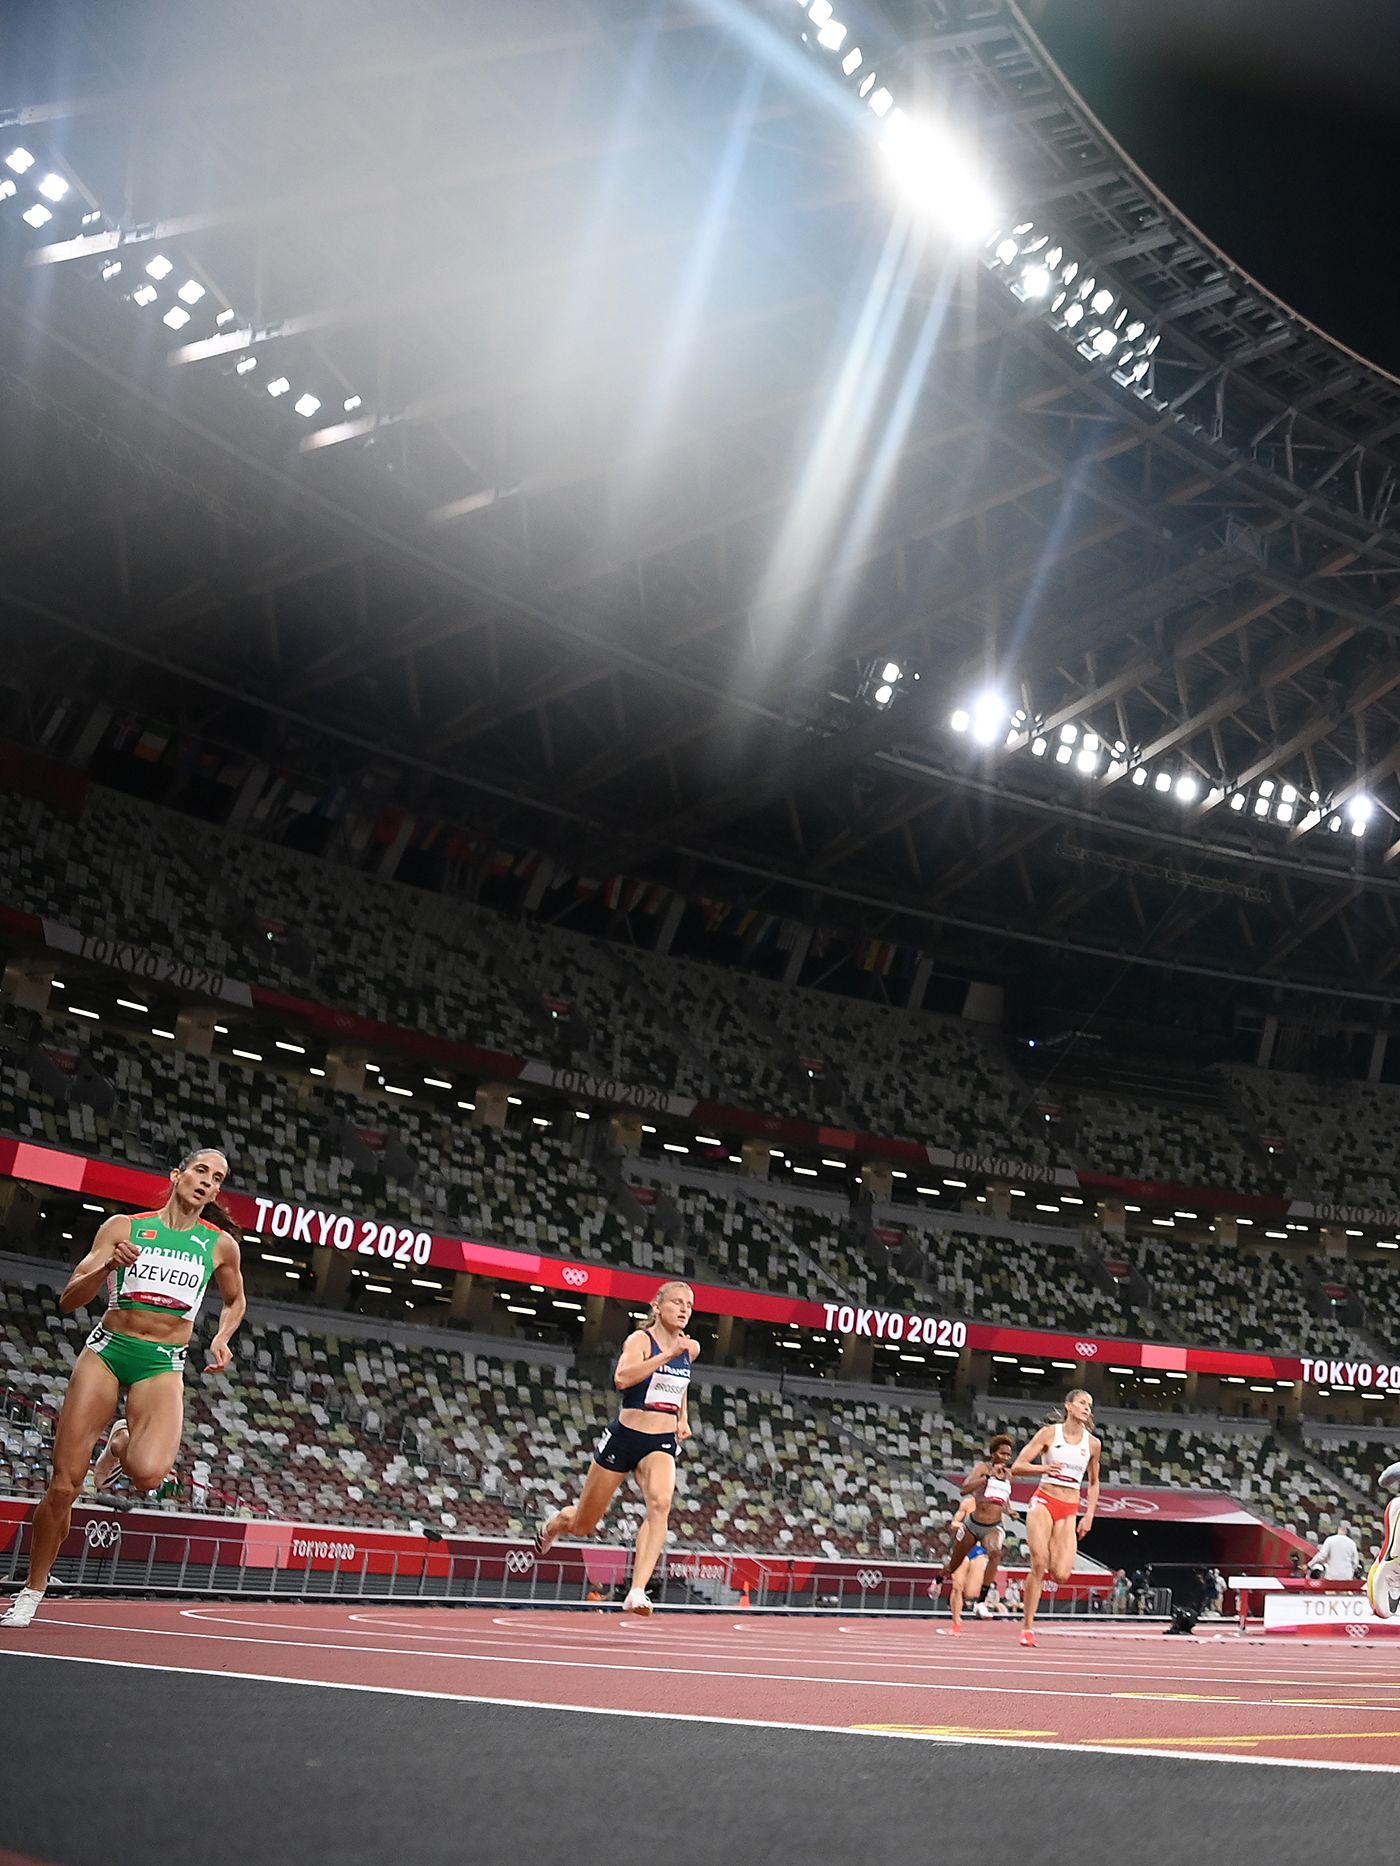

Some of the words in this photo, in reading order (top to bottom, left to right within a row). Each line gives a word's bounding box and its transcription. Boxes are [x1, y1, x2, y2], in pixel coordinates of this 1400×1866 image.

[79, 935, 161, 976] TOKYO
[164, 961, 223, 997] 2020
[551, 1069, 616, 1099] TOKYO
[622, 1085, 669, 1112] 2020
[256, 1197, 355, 1250] TOKYO
[357, 1221, 432, 1265] 2020
[128, 1264, 199, 1289] AZEVEDO
[823, 1303, 904, 1340] TOKYO
[906, 1316, 967, 1348] 2020
[1300, 1358, 1373, 1387] TOKYO
[292, 1539, 328, 1558] TOKYO
[327, 1541, 355, 1560] 2020
[1304, 1600, 1363, 1617] TOKYO
